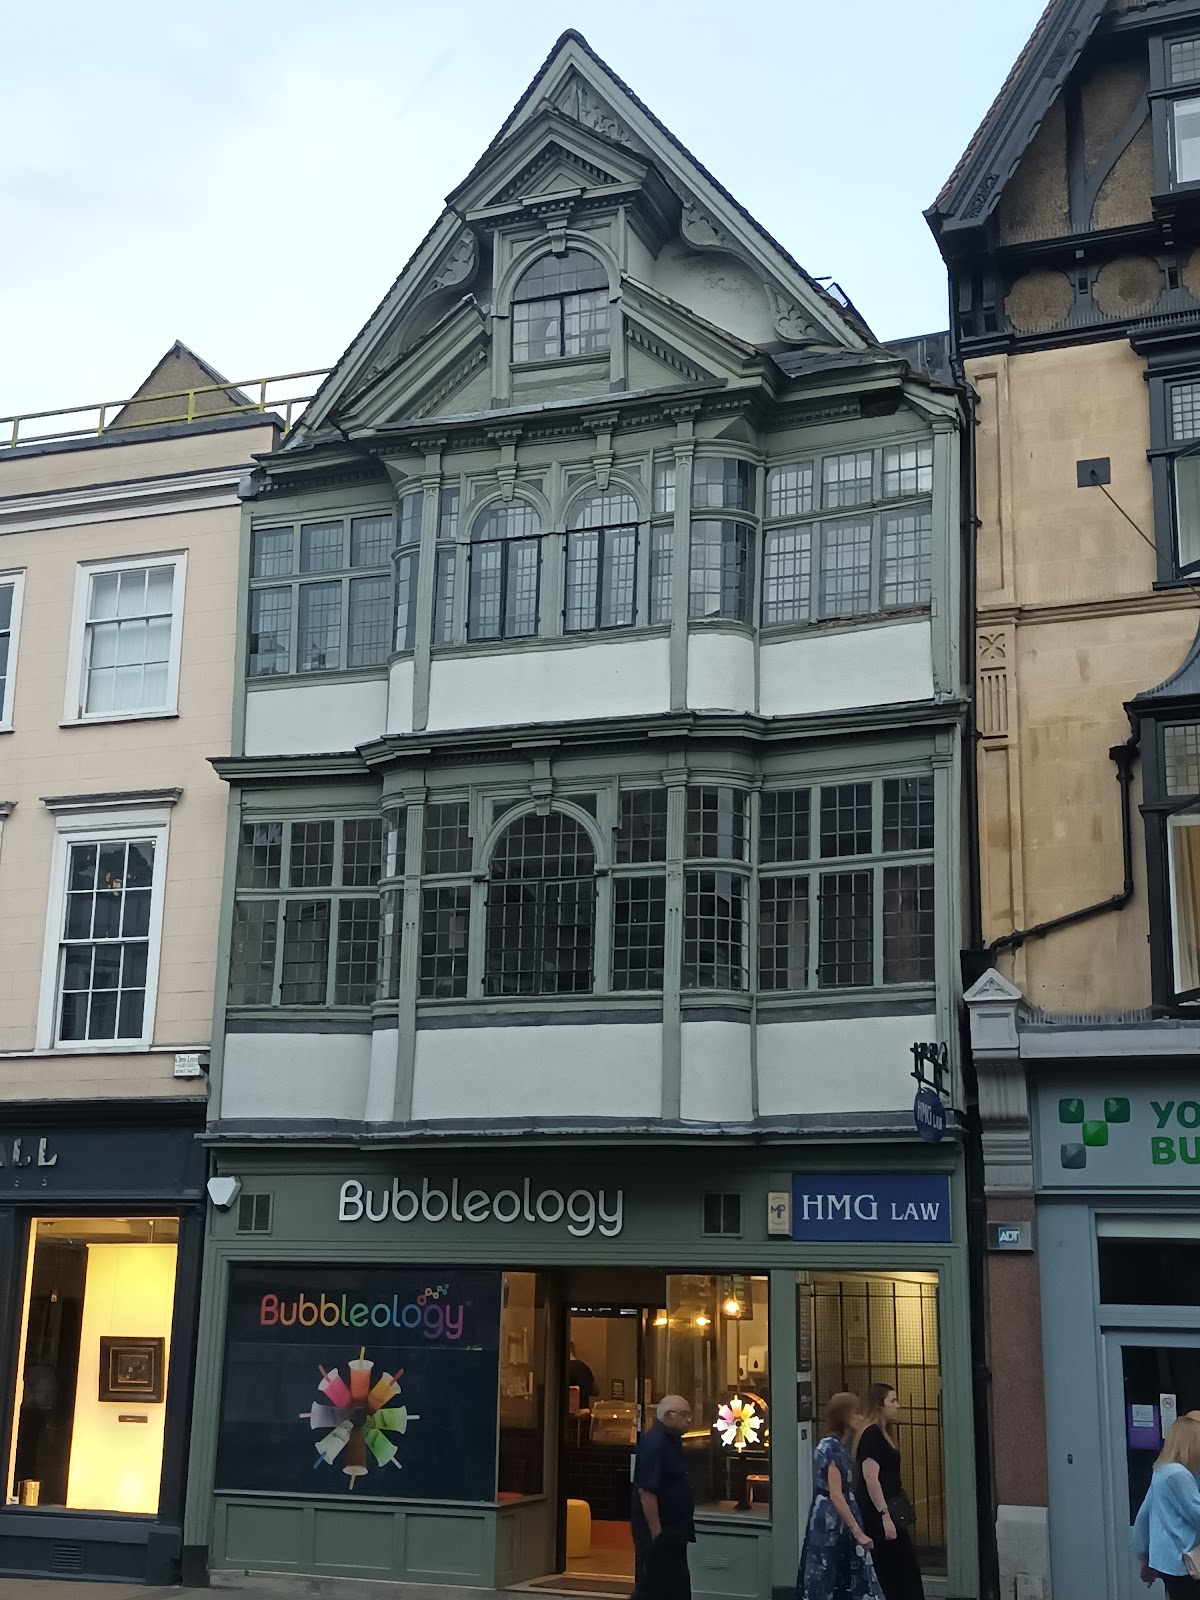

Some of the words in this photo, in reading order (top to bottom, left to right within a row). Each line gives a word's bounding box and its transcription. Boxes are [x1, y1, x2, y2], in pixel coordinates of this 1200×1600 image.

[917, 1100, 932, 1127] HMG
[0, 1137, 58, 1166] LL
[338, 1177, 624, 1237] Bubbleology
[802, 1194, 878, 1221] HMG
[891, 1202, 940, 1221] LAW
[999, 1230, 1020, 1242] ADT
[260, 1292, 464, 1340] Bubbleology
